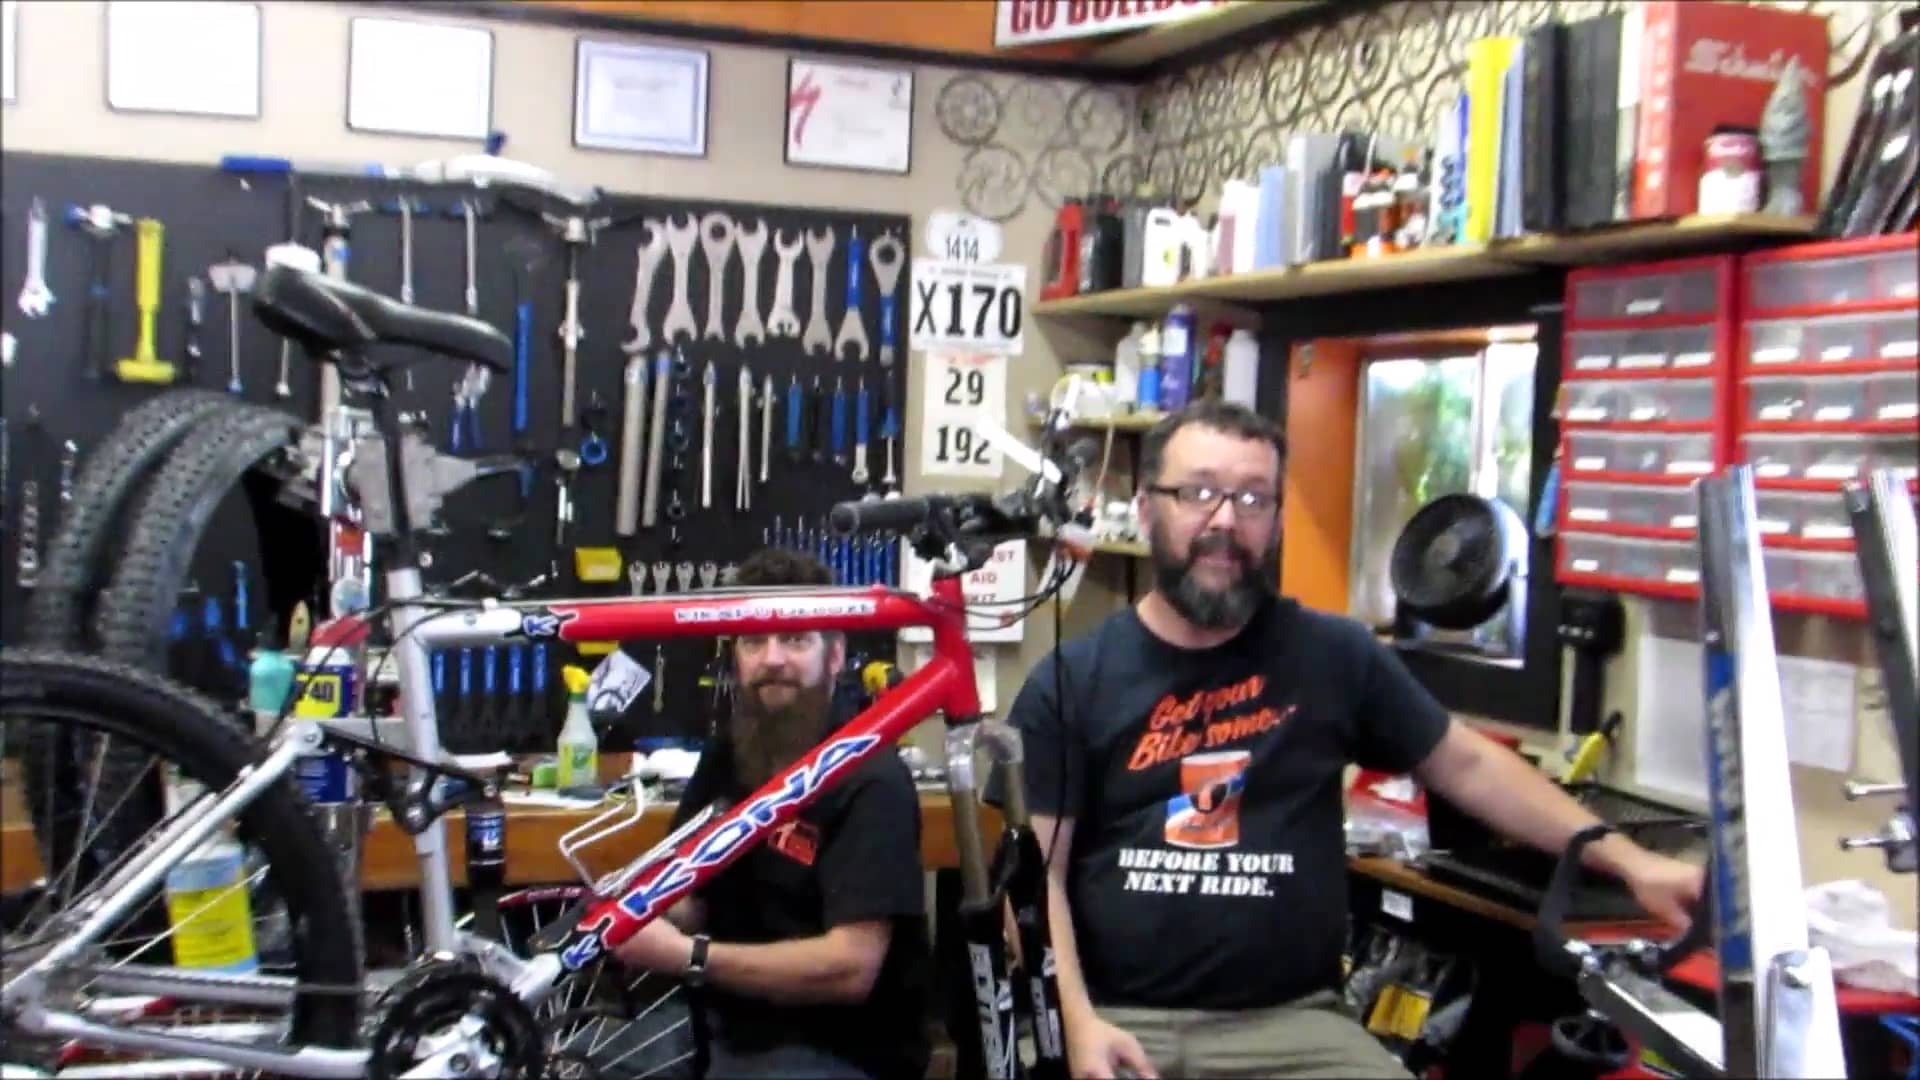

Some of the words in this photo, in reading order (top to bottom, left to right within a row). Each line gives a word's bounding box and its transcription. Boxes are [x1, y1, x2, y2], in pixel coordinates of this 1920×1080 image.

[946, 233, 979, 263] 1414
[914, 279, 1022, 339] X170
[944, 366, 984, 405] 29
[1149, 692, 1205, 732] Get
[1202, 674, 1266, 724] your
[618, 734, 881, 916] KONA
[1118, 848, 1220, 872] BEFORE
[1226, 852, 1294, 873] YOUR
[1123, 871, 1196, 893] NEXT
[1199, 875, 1275, 897] RIDE.
